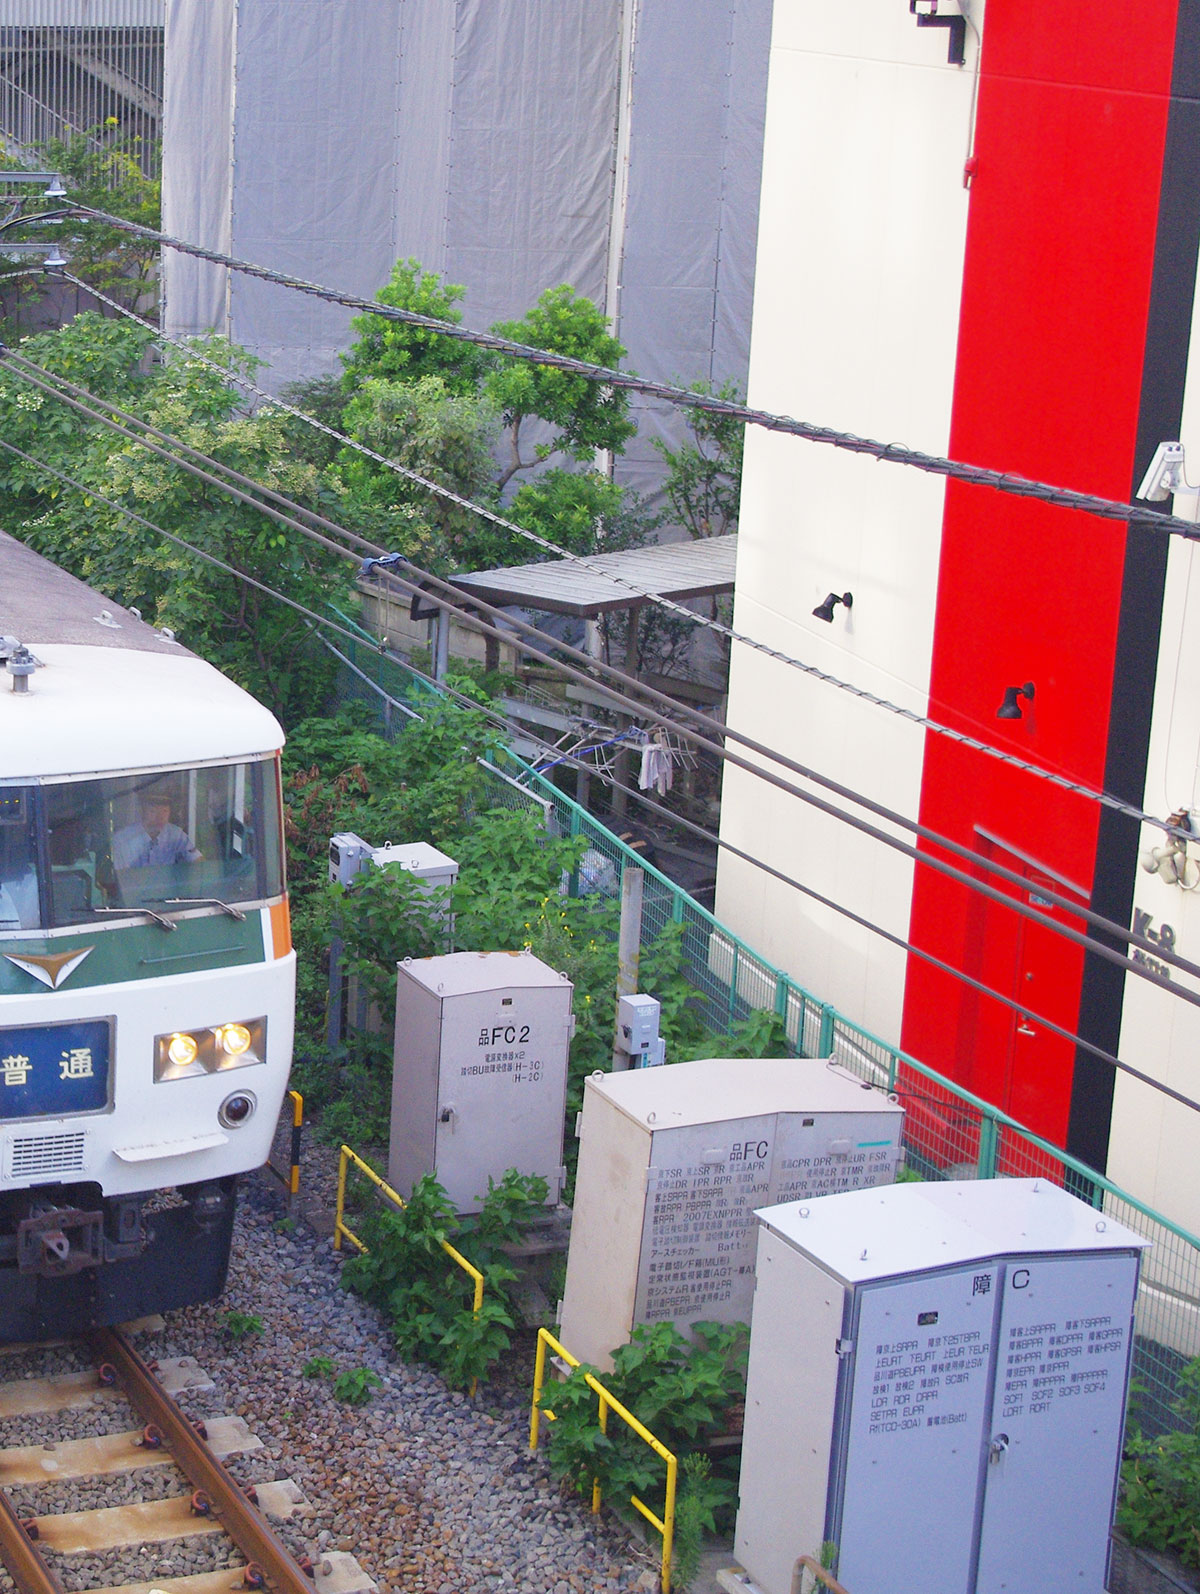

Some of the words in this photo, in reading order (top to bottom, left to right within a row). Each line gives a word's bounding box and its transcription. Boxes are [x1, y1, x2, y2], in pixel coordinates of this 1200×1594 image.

[729, 1140, 769, 1161] 品FC
[813, 1156, 832, 1167] DPR
[713, 1175, 733, 1186] RPR
[972, 1274, 992, 1296] 障
[1012, 1269, 1030, 1289] C
